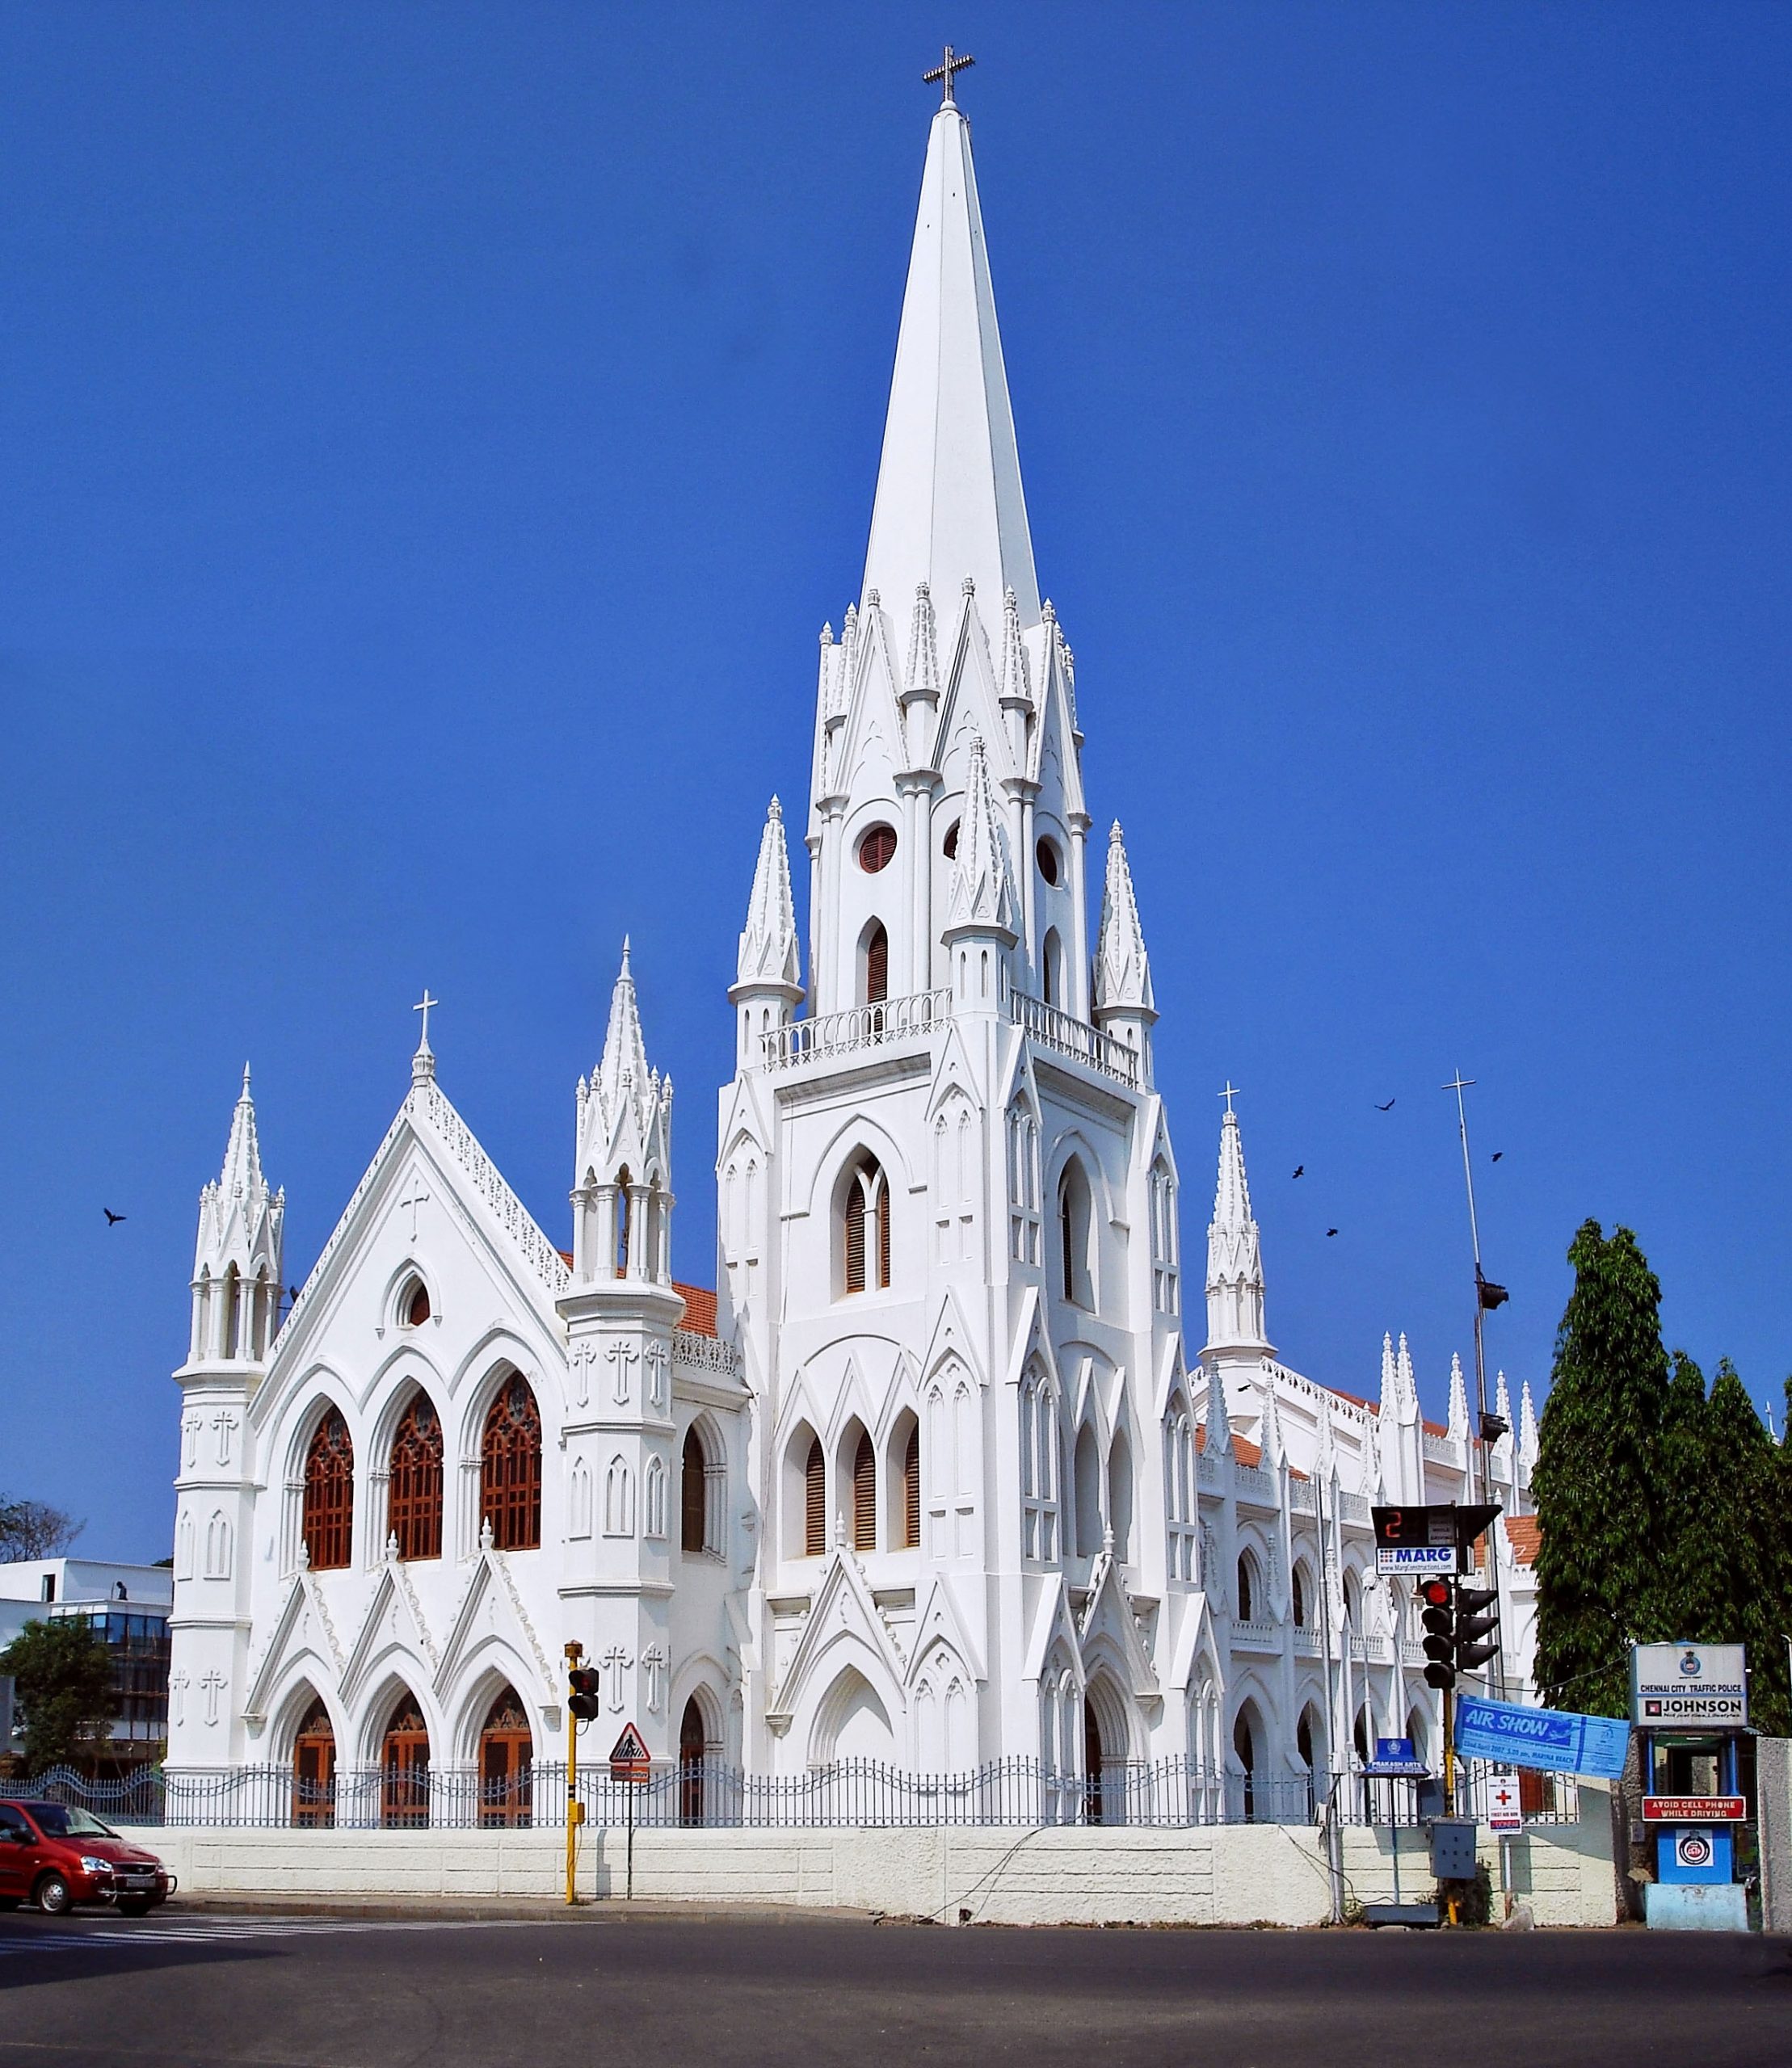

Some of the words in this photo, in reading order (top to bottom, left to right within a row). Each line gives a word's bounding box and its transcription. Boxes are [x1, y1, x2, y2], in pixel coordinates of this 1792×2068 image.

[1395, 1548, 1452, 1562] MARG
[1640, 1684, 1670, 1693] CHENNAI
[1671, 1684, 1686, 1693] CITY
[1689, 1684, 1716, 1693] TRAFFIC
[1718, 1684, 1742, 1693] POLICE
[1663, 1700, 1742, 1713] JOHNSON
[1466, 1709, 1495, 1730] AIR
[1496, 1714, 1549, 1738] SHOW
[1532, 1751, 1554, 1761] MARINA
[1555, 1755, 1574, 1764] BEACH
[1661, 1810, 1689, 1818] WHILE
[1691, 1810, 1727, 1818] DRIVING
